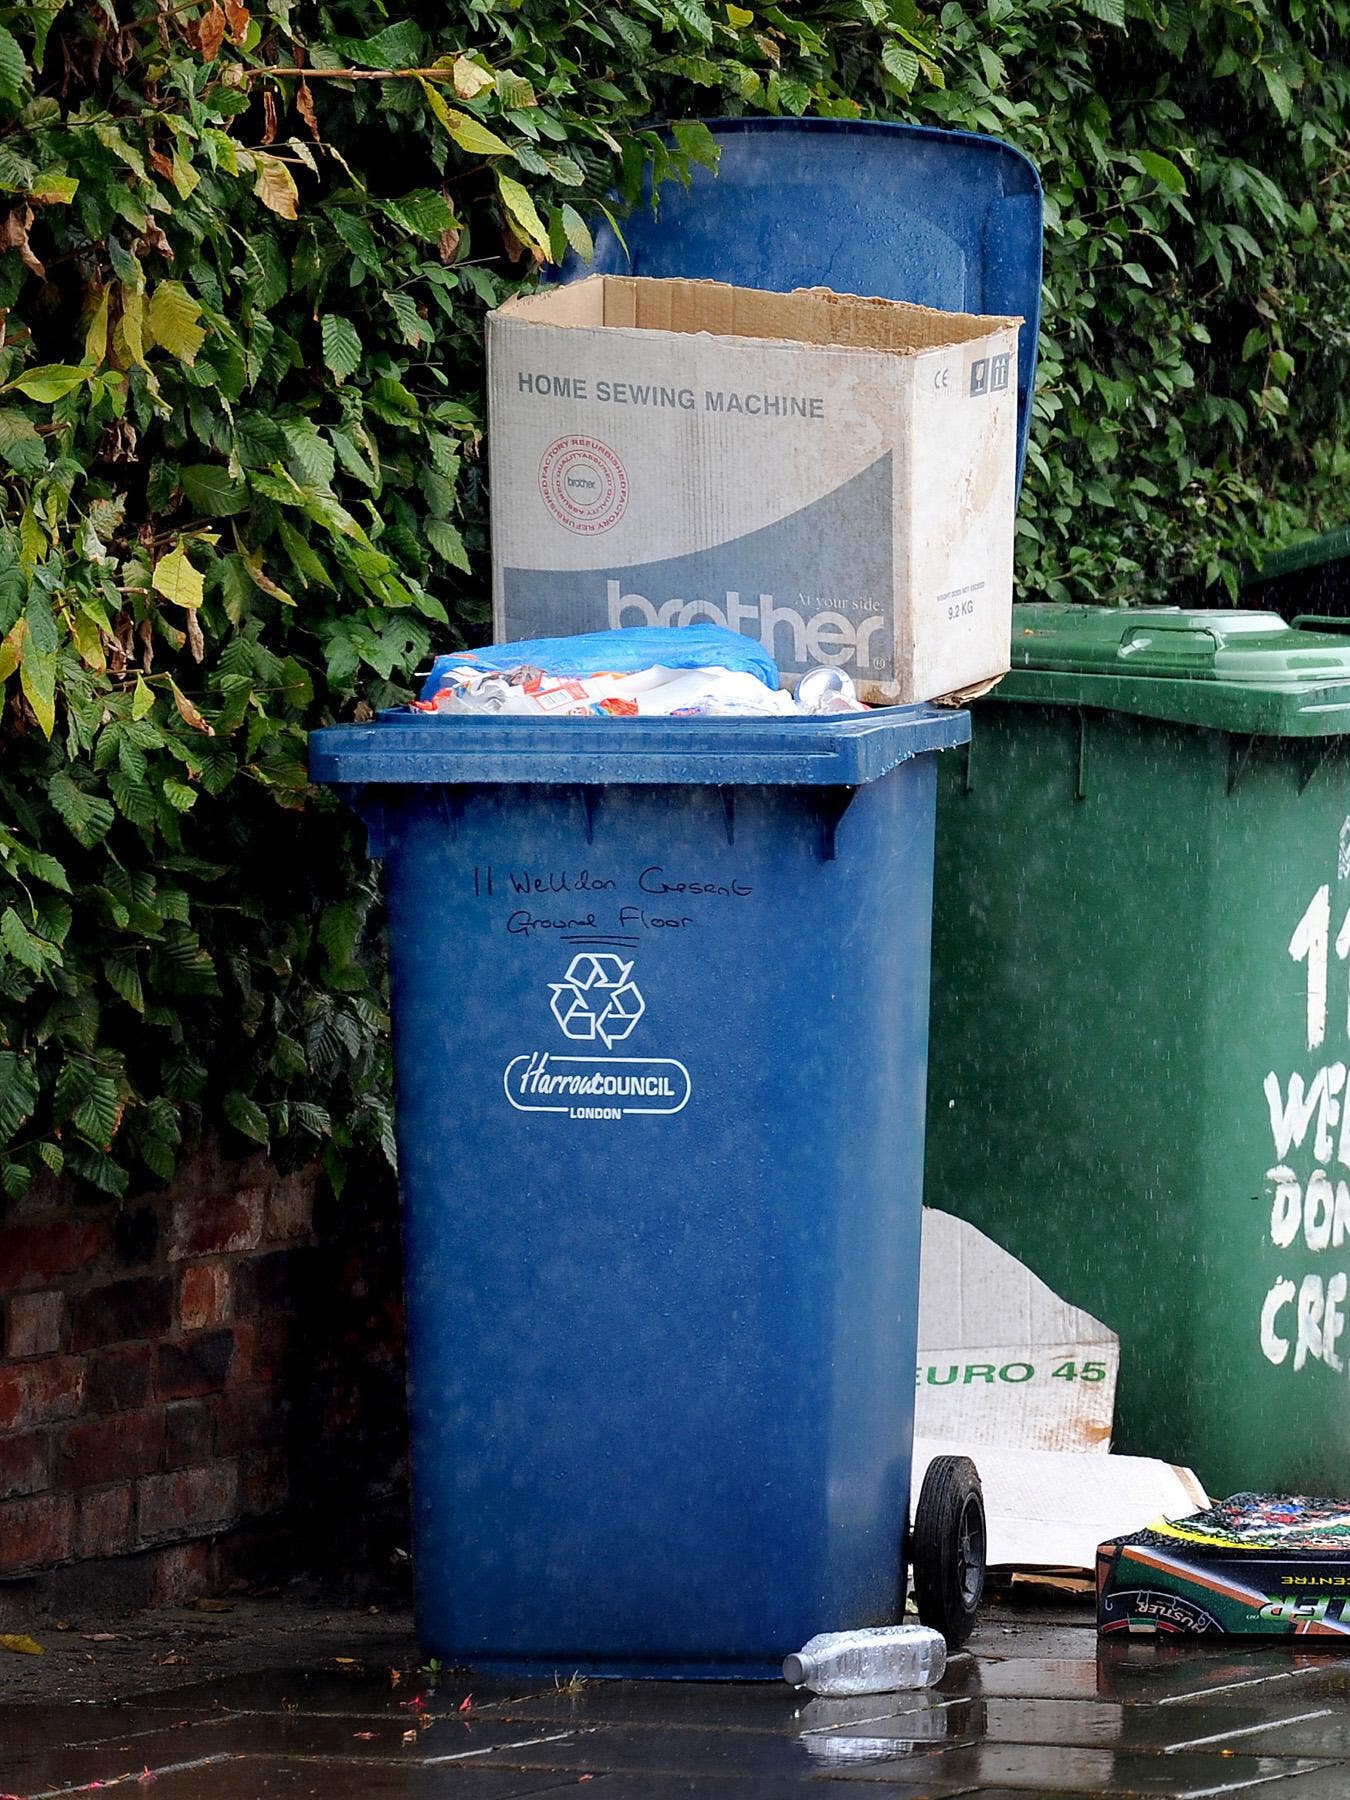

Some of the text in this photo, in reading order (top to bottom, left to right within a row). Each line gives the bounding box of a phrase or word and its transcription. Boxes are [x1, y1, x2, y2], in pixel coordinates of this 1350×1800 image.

[518, 372, 825, 419] HOME SEWING MACHINE
[815, 597, 848, 611] your
[961, 600, 974, 616] KG
[474, 866, 493, 896] 11
[509, 870, 616, 894] Welldon
[506, 906, 694, 937] Ground Floor
[569, 1107, 622, 1120] LONDON
[916, 1361, 1107, 1386] URO 45
[1137, 1603, 1204, 1633] HUSTLER
